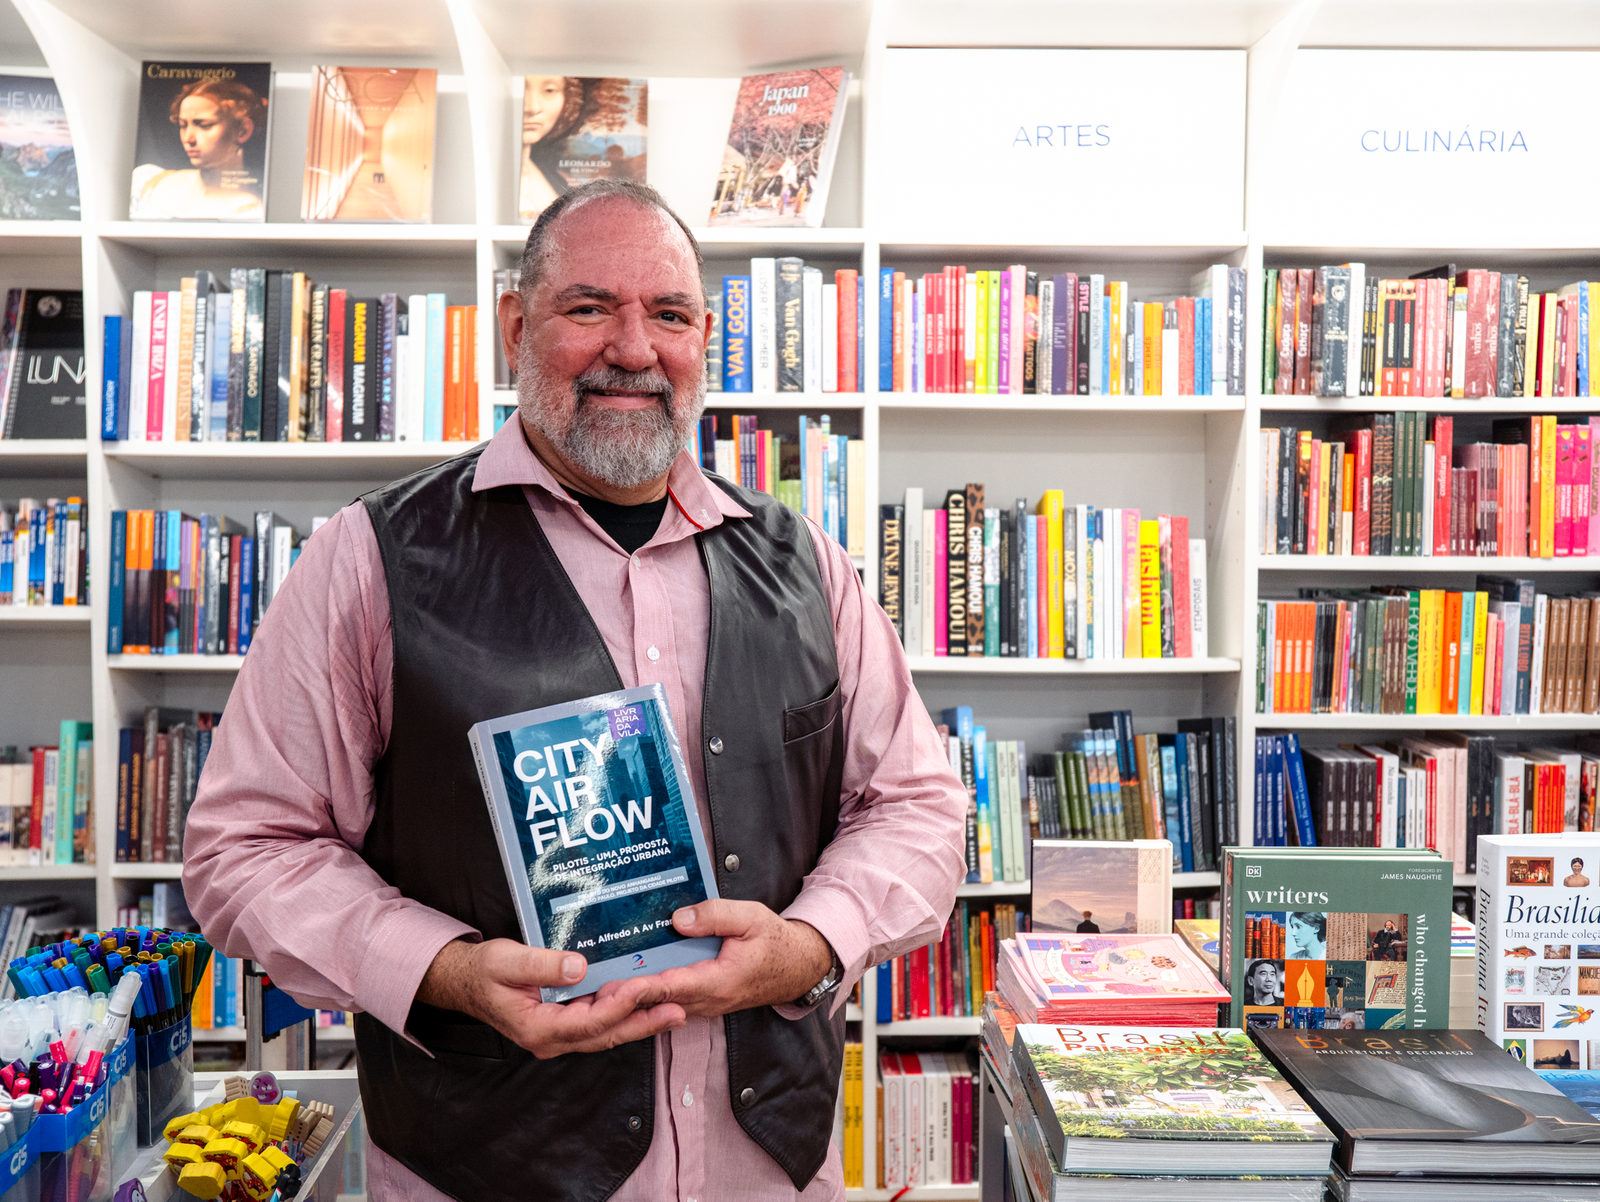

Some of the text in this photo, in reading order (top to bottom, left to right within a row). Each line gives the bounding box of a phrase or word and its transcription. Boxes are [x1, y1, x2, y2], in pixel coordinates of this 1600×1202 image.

[147, 63, 236, 82] Caravaggio
[759, 84, 809, 108] Japan
[767, 102, 797, 117] 1900
[1011, 124, 1111, 147] ARTES
[1361, 124, 1529, 153] CULINÁRIA
[558, 159, 612, 169] LEONARDO
[883, 274, 891, 298] MODA
[1079, 284, 1089, 313] STYLE
[311, 291, 325, 343] BAHRAIN
[1518, 283, 1529, 328] WINE FOLLY
[150, 299, 167, 380] INSIDE IBIZA
[726, 279, 744, 377] VAN GOGH
[782, 298, 801, 369] Van Gogh
[1280, 323, 1291, 357] Cachaça
[1297, 322, 1309, 357] Cachaça
[1470, 322, 1483, 355] vinhos
[1486, 324, 1498, 358] vinhos
[1025, 340, 1034, 381] TATTOOS
[1127, 333, 1135, 362] CHANEL
[247, 346, 259, 398] SANTIAGO
[309, 344, 323, 388] CRAFTS
[352, 302, 367, 425] MAGNUM MAGNUM
[104, 380, 116, 433] ARQUITETURA
[177, 367, 191, 422] HOMES
[884, 519, 900, 570] DIVINE
[913, 574, 920, 584] DE
[949, 493, 966, 641] CHRIS HAMOUI
[968, 526, 982, 614] CHRIS HAMOUI
[1141, 544, 1160, 626] fashion
[1193, 579, 1203, 632] ATEMPORAIS
[1449, 642, 1458, 656] 5
[1475, 642, 1484, 656] VEG
[1518, 623, 1531, 645] RITA
[1406, 607, 1419, 700] FOGO VERDE
[1517, 646, 1530, 672] LOBO
[613, 706, 637, 718] LIVR
[615, 713, 640, 725] ARIA
[616, 722, 631, 731] DA
[617, 727, 641, 738] VILA
[513, 732, 607, 784] CITY
[524, 773, 597, 821] AIR
[1027, 775, 1039, 823] amazonas
[1386, 765, 1395, 805] Na cozinha
[1506, 776, 1521, 834] BLÁ-BLÁ-BLÁ
[529, 796, 653, 856] FLOW
[552, 856, 589, 873] PILOTIS
[596, 849, 619, 862] UMA
[619, 837, 669, 855] PROPOSTA
[555, 846, 671, 881] DE INTEGRAÇÃO URBANA
[1247, 866, 1260, 876] DK
[1381, 873, 1442, 881] JAMES NAUGHTIE
[610, 883, 626, 893] NOVO
[615, 887, 639, 896] PROJETO
[647, 880, 666, 889] CIDADE
[1246, 886, 1329, 905] writers
[577, 938, 597, 950] Arq.
[598, 928, 631, 944] Alfredo
[633, 926, 641, 935] A
[641, 922, 654, 933] Av
[1415, 913, 1426, 944] who
[1477, 886, 1491, 991] Brasiliana
[1505, 929, 1531, 940] Uma
[1533, 929, 1569, 942] grande
[1411, 949, 1428, 1014] changed
[169, 1023, 189, 1053] CiS
[1055, 1026, 1230, 1047] Brasil
[1064, 1042, 1233, 1055] Paisagistas
[1295, 1033, 1474, 1052] Brasil
[113, 1048, 127, 1075] CiS
[1314, 1049, 1393, 1057] ARQUITETURA
[1406, 1049, 1474, 1057] DECORAÇÃO
[89, 1093, 105, 1122] CiS
[9, 1142, 28, 1176] CiS
